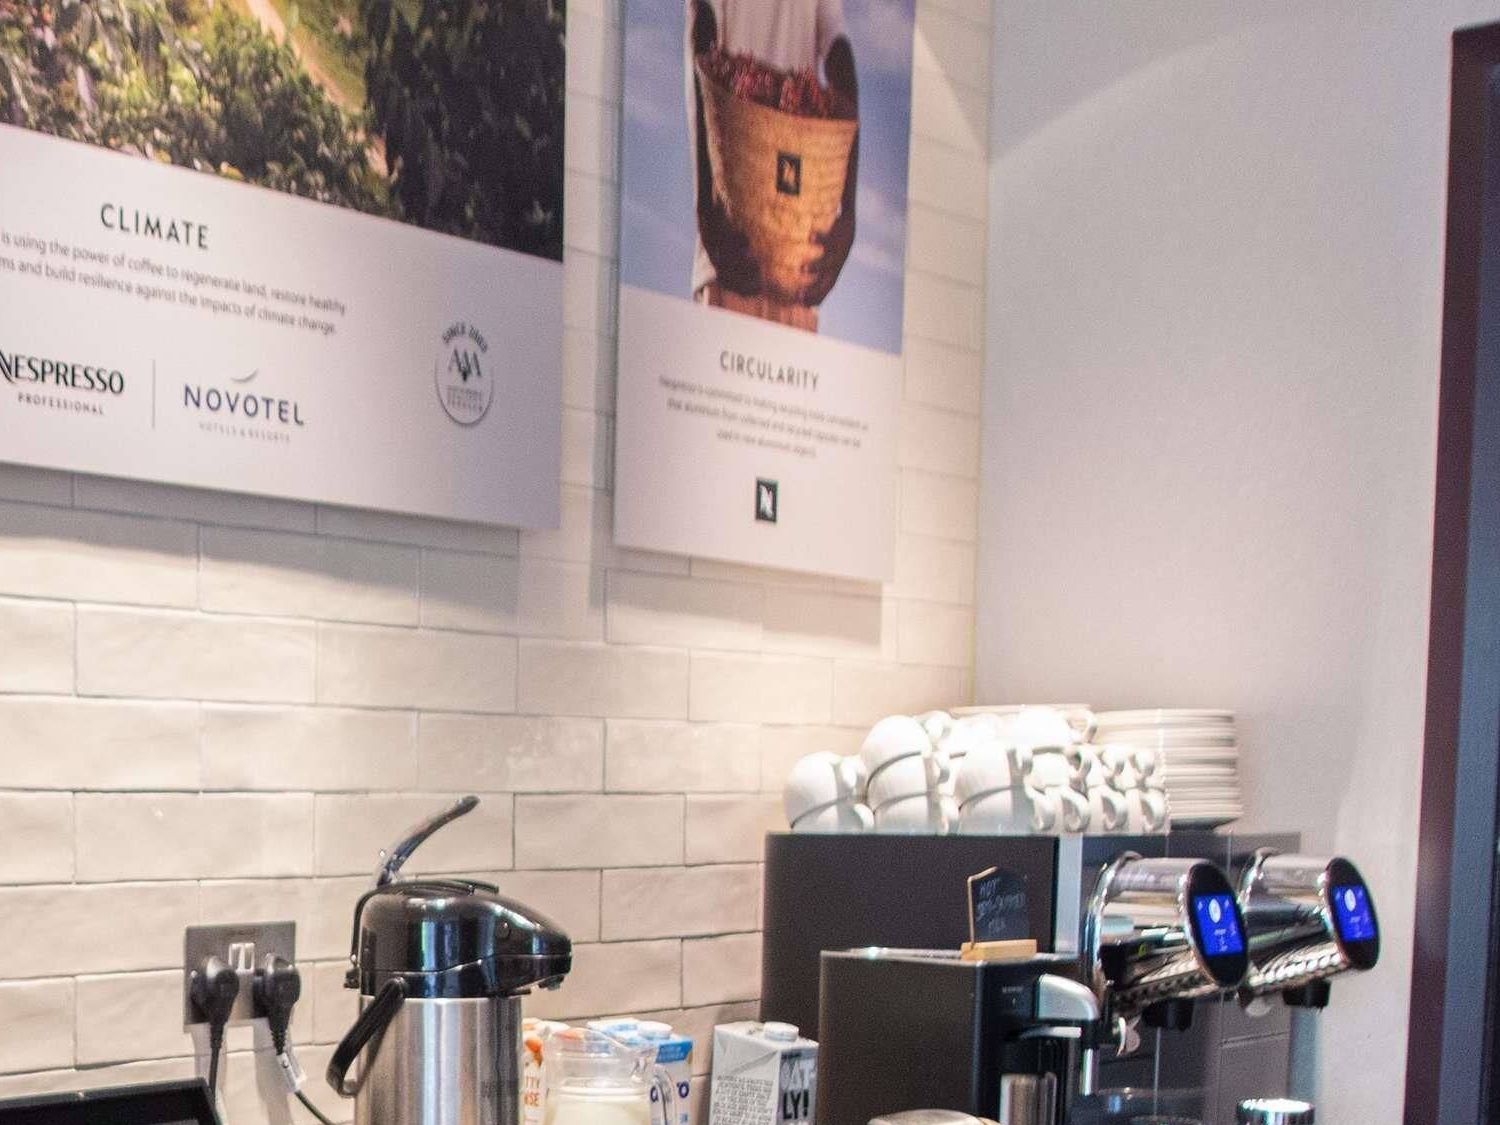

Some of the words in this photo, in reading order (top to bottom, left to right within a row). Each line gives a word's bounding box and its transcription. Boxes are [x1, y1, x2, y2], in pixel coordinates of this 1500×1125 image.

[100, 202, 209, 250] CLIMATE
[1, 233, 11, 245] is
[49, 239, 70, 257] the
[72, 246, 110, 265] power
[112, 253, 126, 268] of
[128, 258, 164, 277] coffee
[166, 264, 180, 280] to
[181, 269, 241, 294] regenerate
[308, 294, 346, 317] healthy
[18, 259, 43, 277] and
[45, 265, 77, 284] build
[78, 271, 133, 295] resilience
[135, 284, 177, 304] against
[178, 292, 198, 307] the
[200, 296, 242, 316] impacts
[244, 303, 256, 319] of
[258, 305, 296, 327] climate
[719, 350, 820, 390] CIRCULARITY
[17, 390, 106, 416] PROFESSIONAL
[183, 383, 305, 427] NOVOTEL
[783, 1089, 810, 1120] LY!
